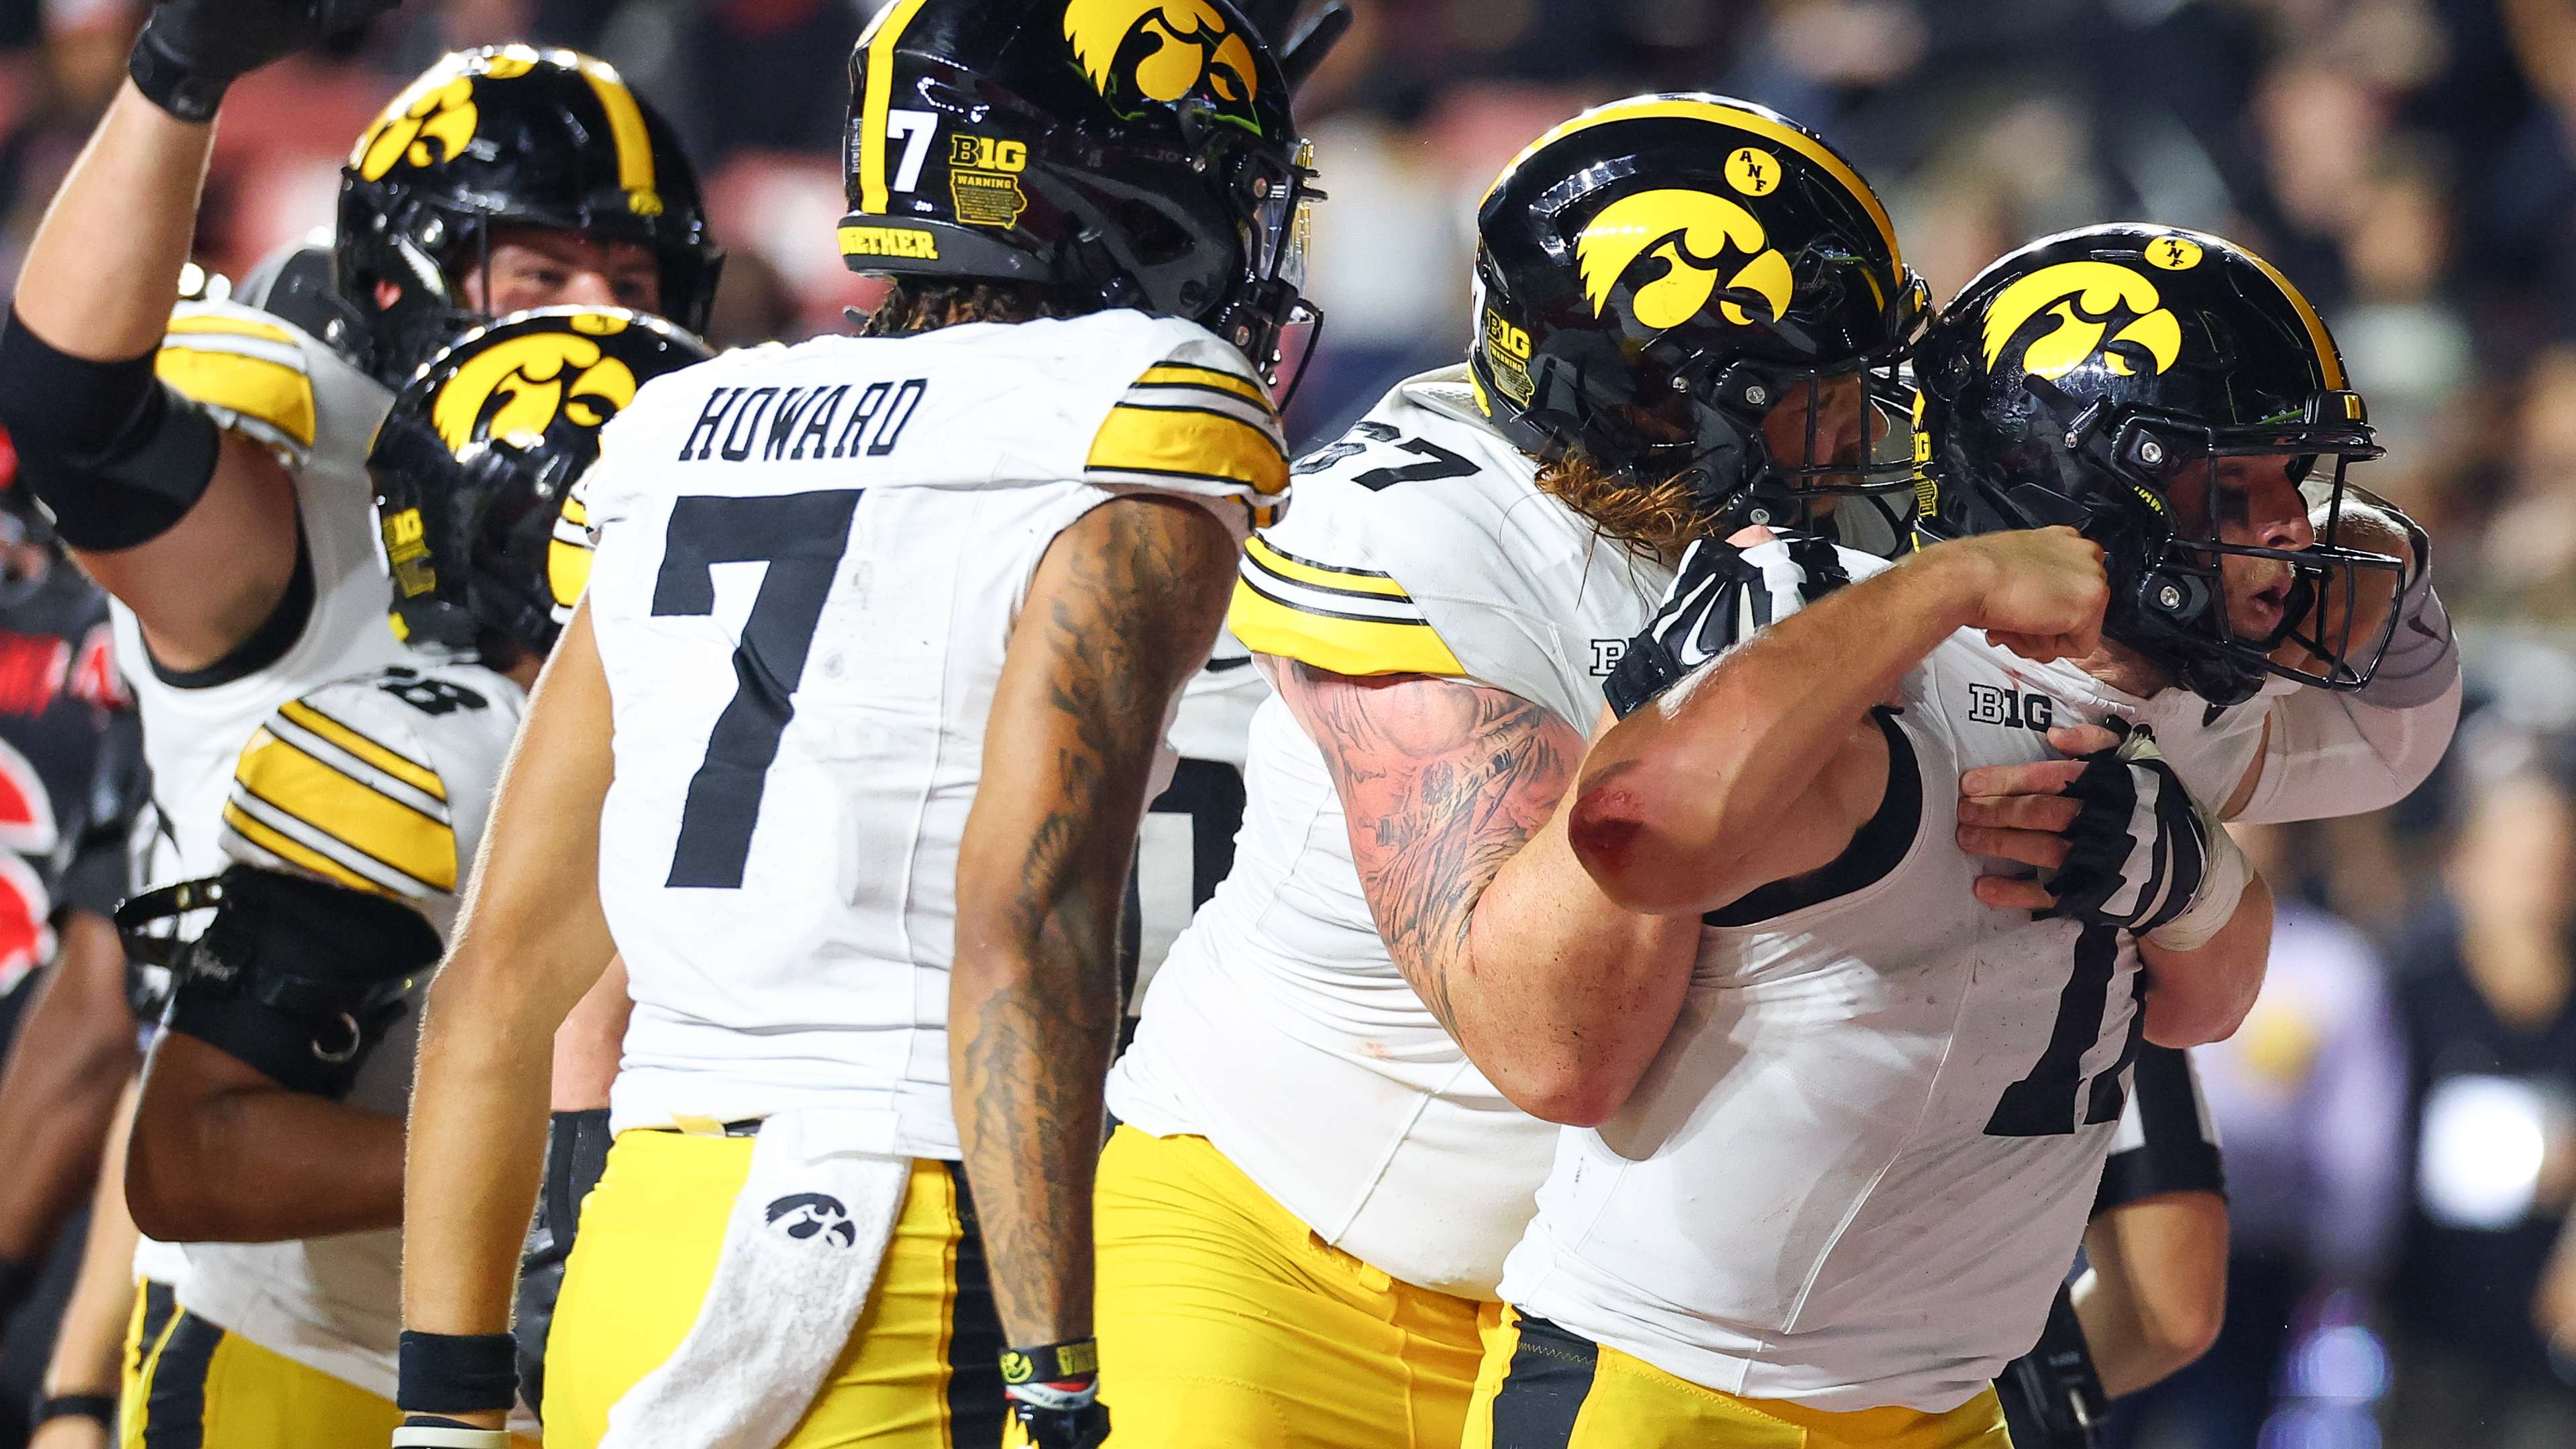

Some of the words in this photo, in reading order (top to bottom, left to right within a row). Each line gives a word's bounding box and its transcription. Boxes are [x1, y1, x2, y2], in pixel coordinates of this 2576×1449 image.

[886, 109, 938, 193] 7
[949, 133, 1028, 172] B1G
[957, 174, 1012, 189] WARNING
[1487, 308, 1530, 359] B1G
[1491, 345, 1523, 373] WARNING
[678, 378, 928, 462] HOWARD
[651, 488, 867, 890] 7
[1968, 683, 2053, 733] B1G
